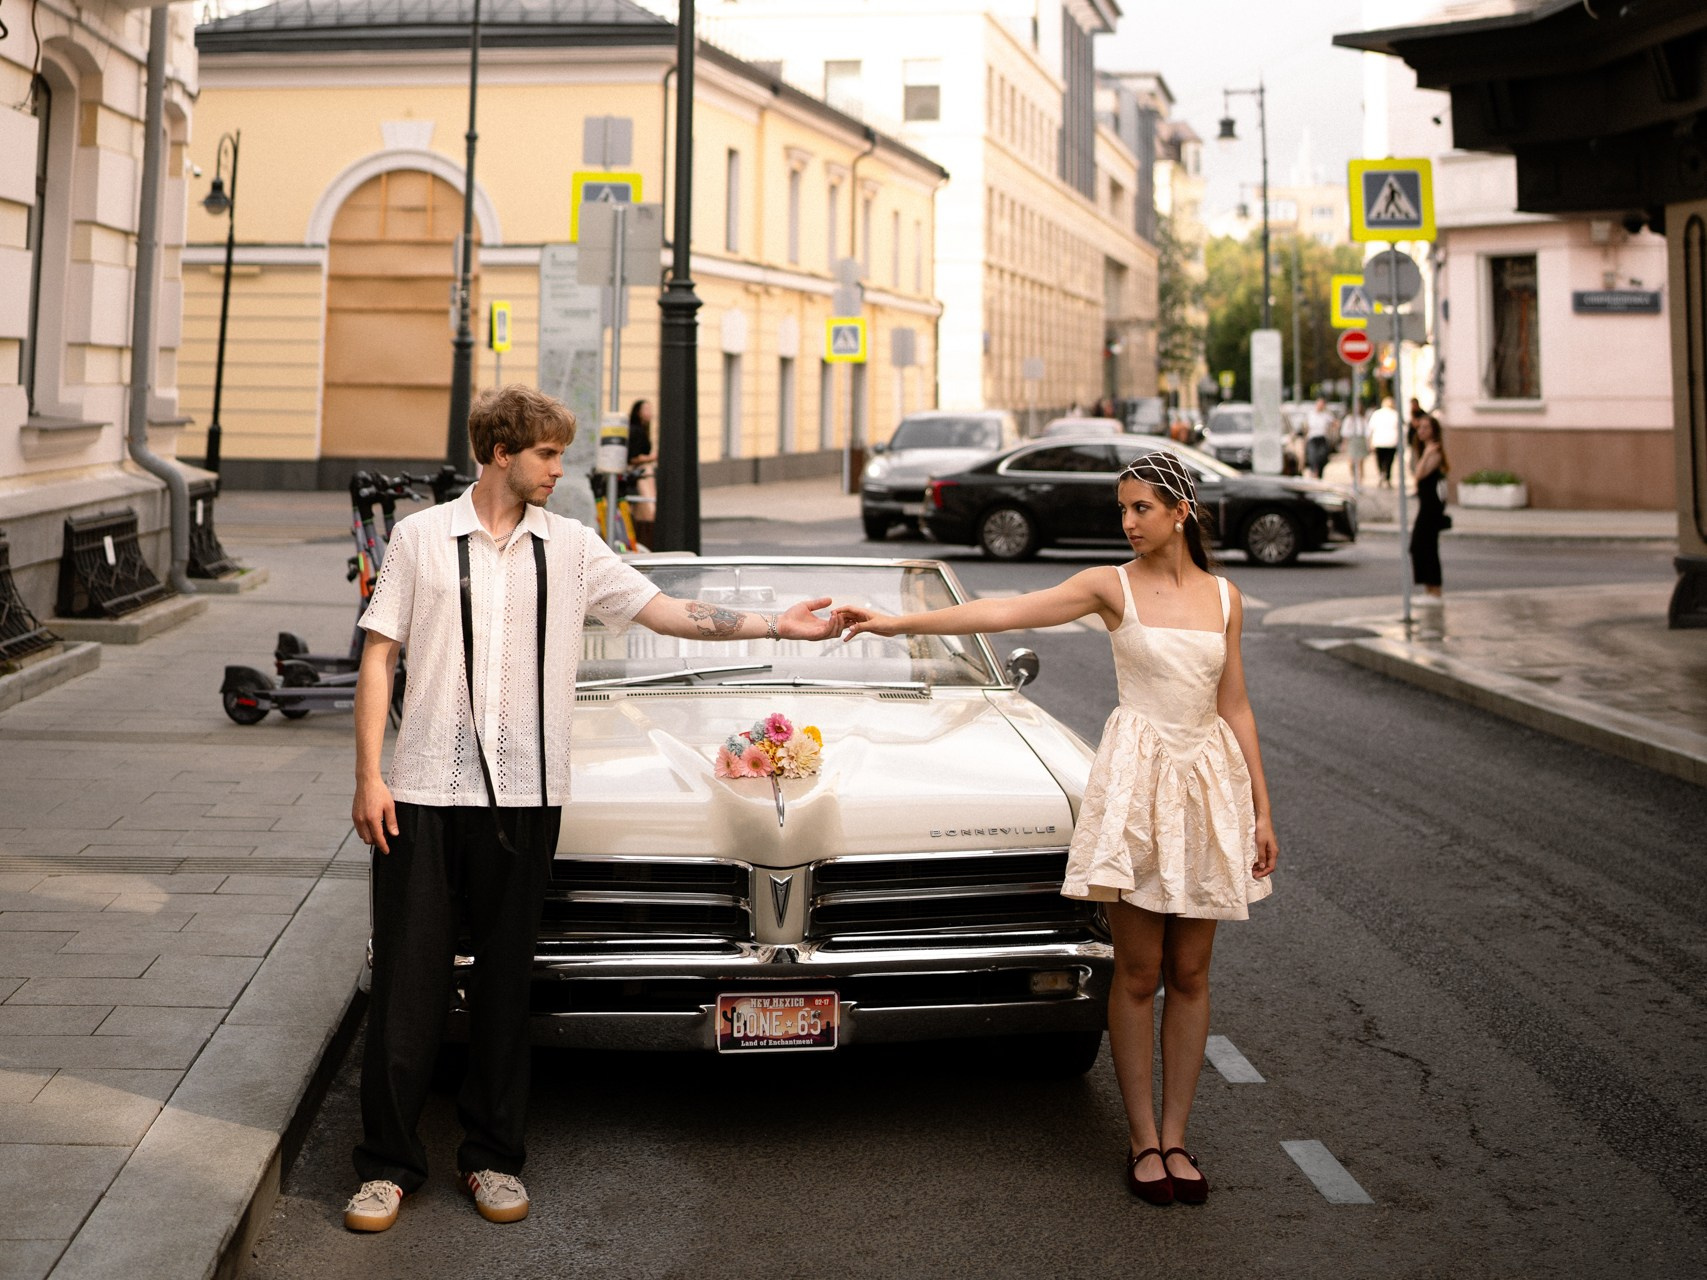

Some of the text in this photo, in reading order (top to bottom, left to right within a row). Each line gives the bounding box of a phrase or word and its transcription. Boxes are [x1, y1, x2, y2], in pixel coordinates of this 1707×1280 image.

[930, 826, 1056, 837] BONNEVILLE
[751, 998, 804, 1009] NEW MEXICO
[733, 1010, 821, 1037] BONE 65
[768, 1038, 813, 1046] Enchantment
